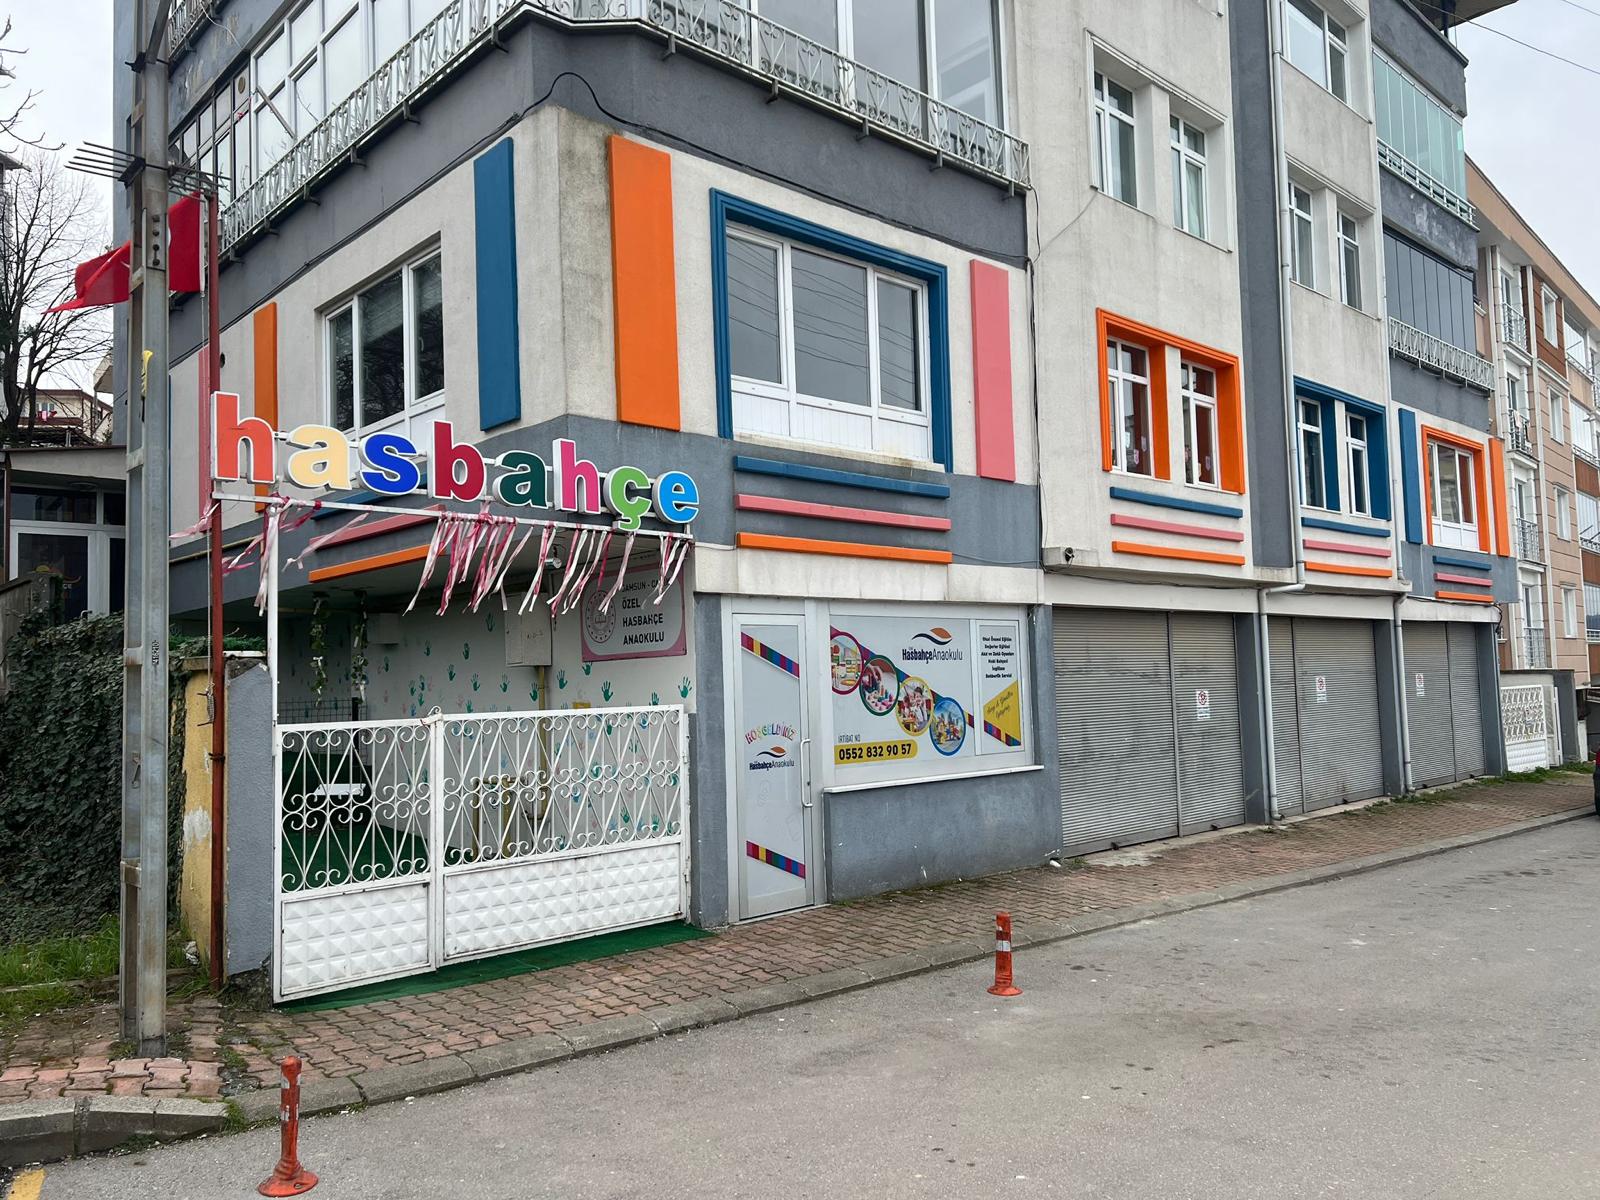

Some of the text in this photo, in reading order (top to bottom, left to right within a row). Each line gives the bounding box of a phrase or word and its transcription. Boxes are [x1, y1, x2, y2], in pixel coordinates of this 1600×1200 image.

[211, 392, 700, 532] hasbahçe
[622, 597, 641, 609] ÖZEL
[622, 613, 664, 628] HASBAHÇE
[623, 631, 665, 646] ANAOKULU
[839, 743, 912, 760] 0552 832 90 57
